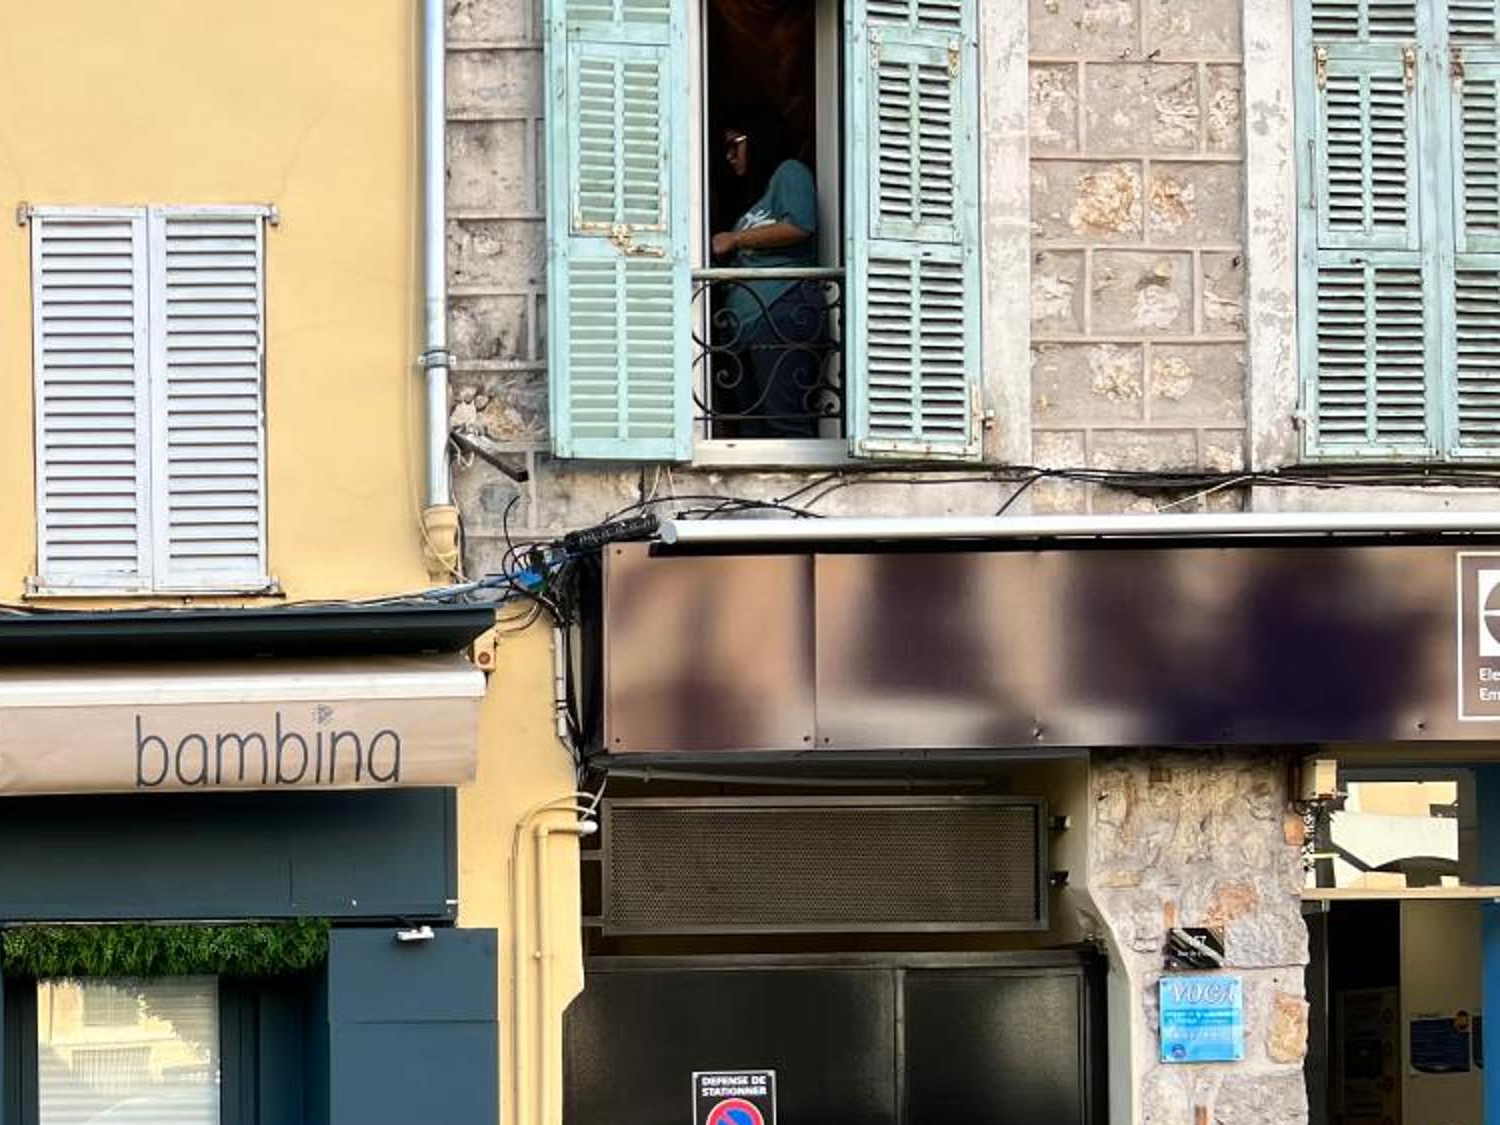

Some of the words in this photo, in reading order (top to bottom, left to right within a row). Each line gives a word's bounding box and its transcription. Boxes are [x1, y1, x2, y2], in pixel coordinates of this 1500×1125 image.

[135, 710, 402, 787] bambina
[701, 1075, 749, 1087] DEFENSE
[750, 1074, 767, 1085] DE
[701, 1085, 768, 1098] STATIONNER
